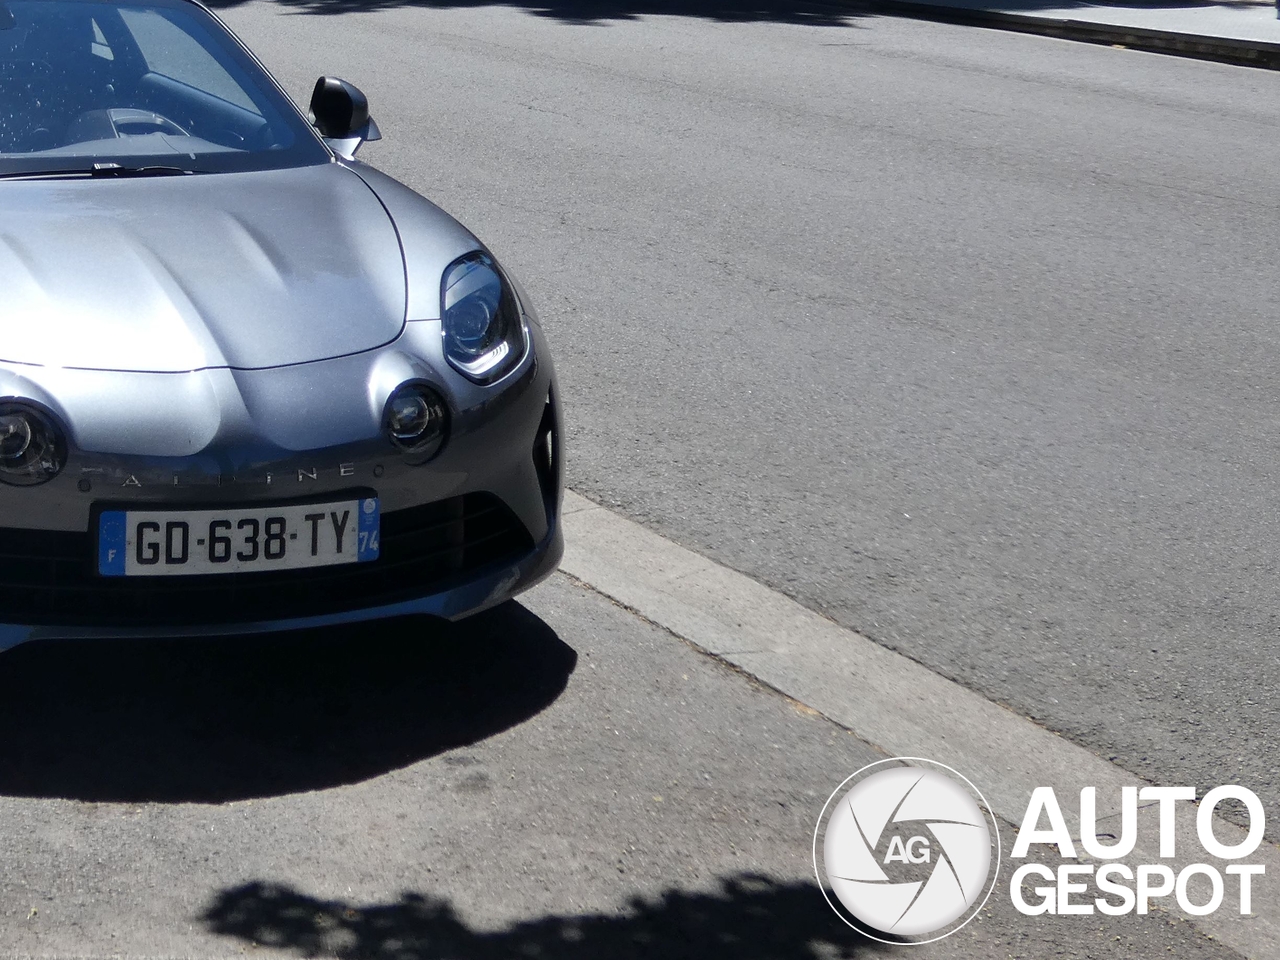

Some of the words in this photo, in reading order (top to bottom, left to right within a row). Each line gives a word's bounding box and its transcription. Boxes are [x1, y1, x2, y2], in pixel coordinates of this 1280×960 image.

[107, 549, 117, 564] F
[136, 510, 350, 566] GD-638-TY
[359, 530, 379, 552] 74
